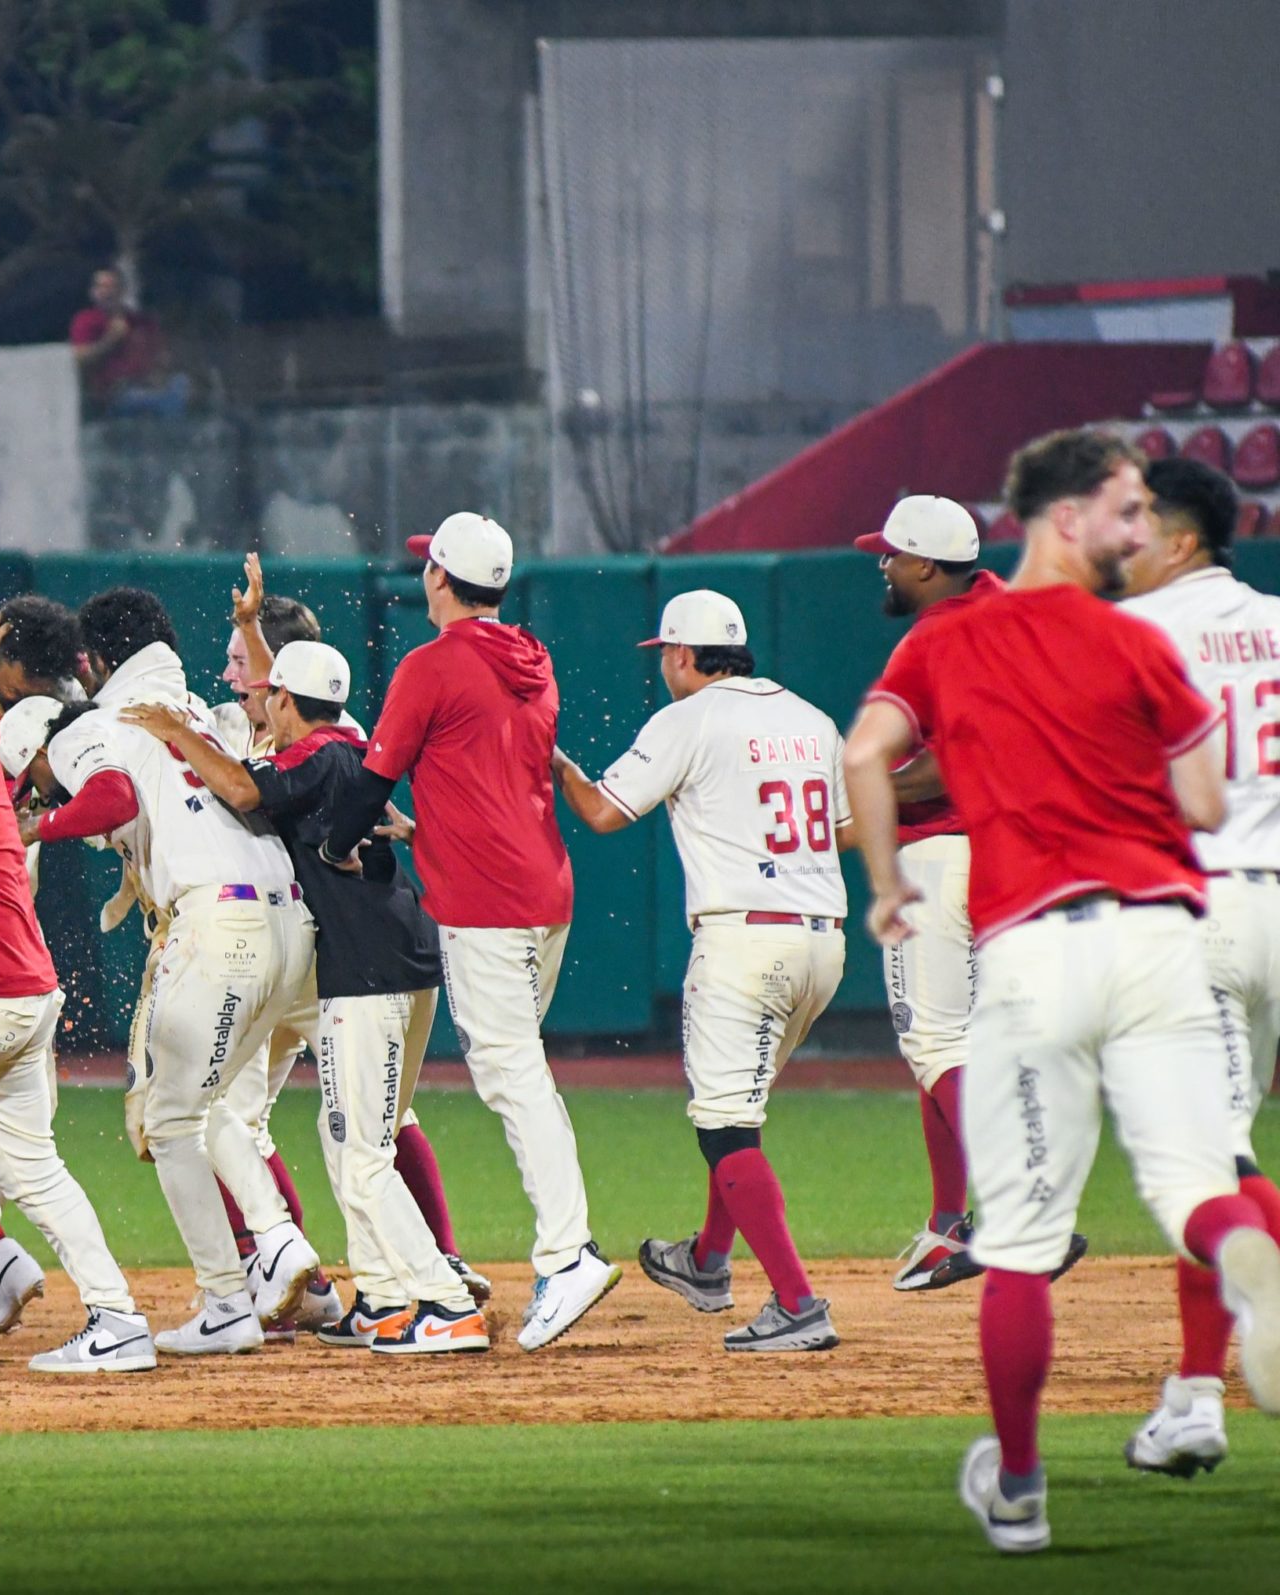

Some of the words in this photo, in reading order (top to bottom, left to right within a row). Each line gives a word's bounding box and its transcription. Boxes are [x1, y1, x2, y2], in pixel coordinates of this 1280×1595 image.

[748, 737, 822, 763] SAINZ
[1221, 680, 1280, 781] 12
[757, 778, 832, 855] 38
[224, 952, 257, 960] DELTA
[761, 973, 791, 982] DELTA
[891, 943, 904, 999] CAFIVE
[210, 992, 241, 1067] Totalplay
[321, 1036, 333, 1109] CAFIVER
[382, 1040, 400, 1124] Totalplay
